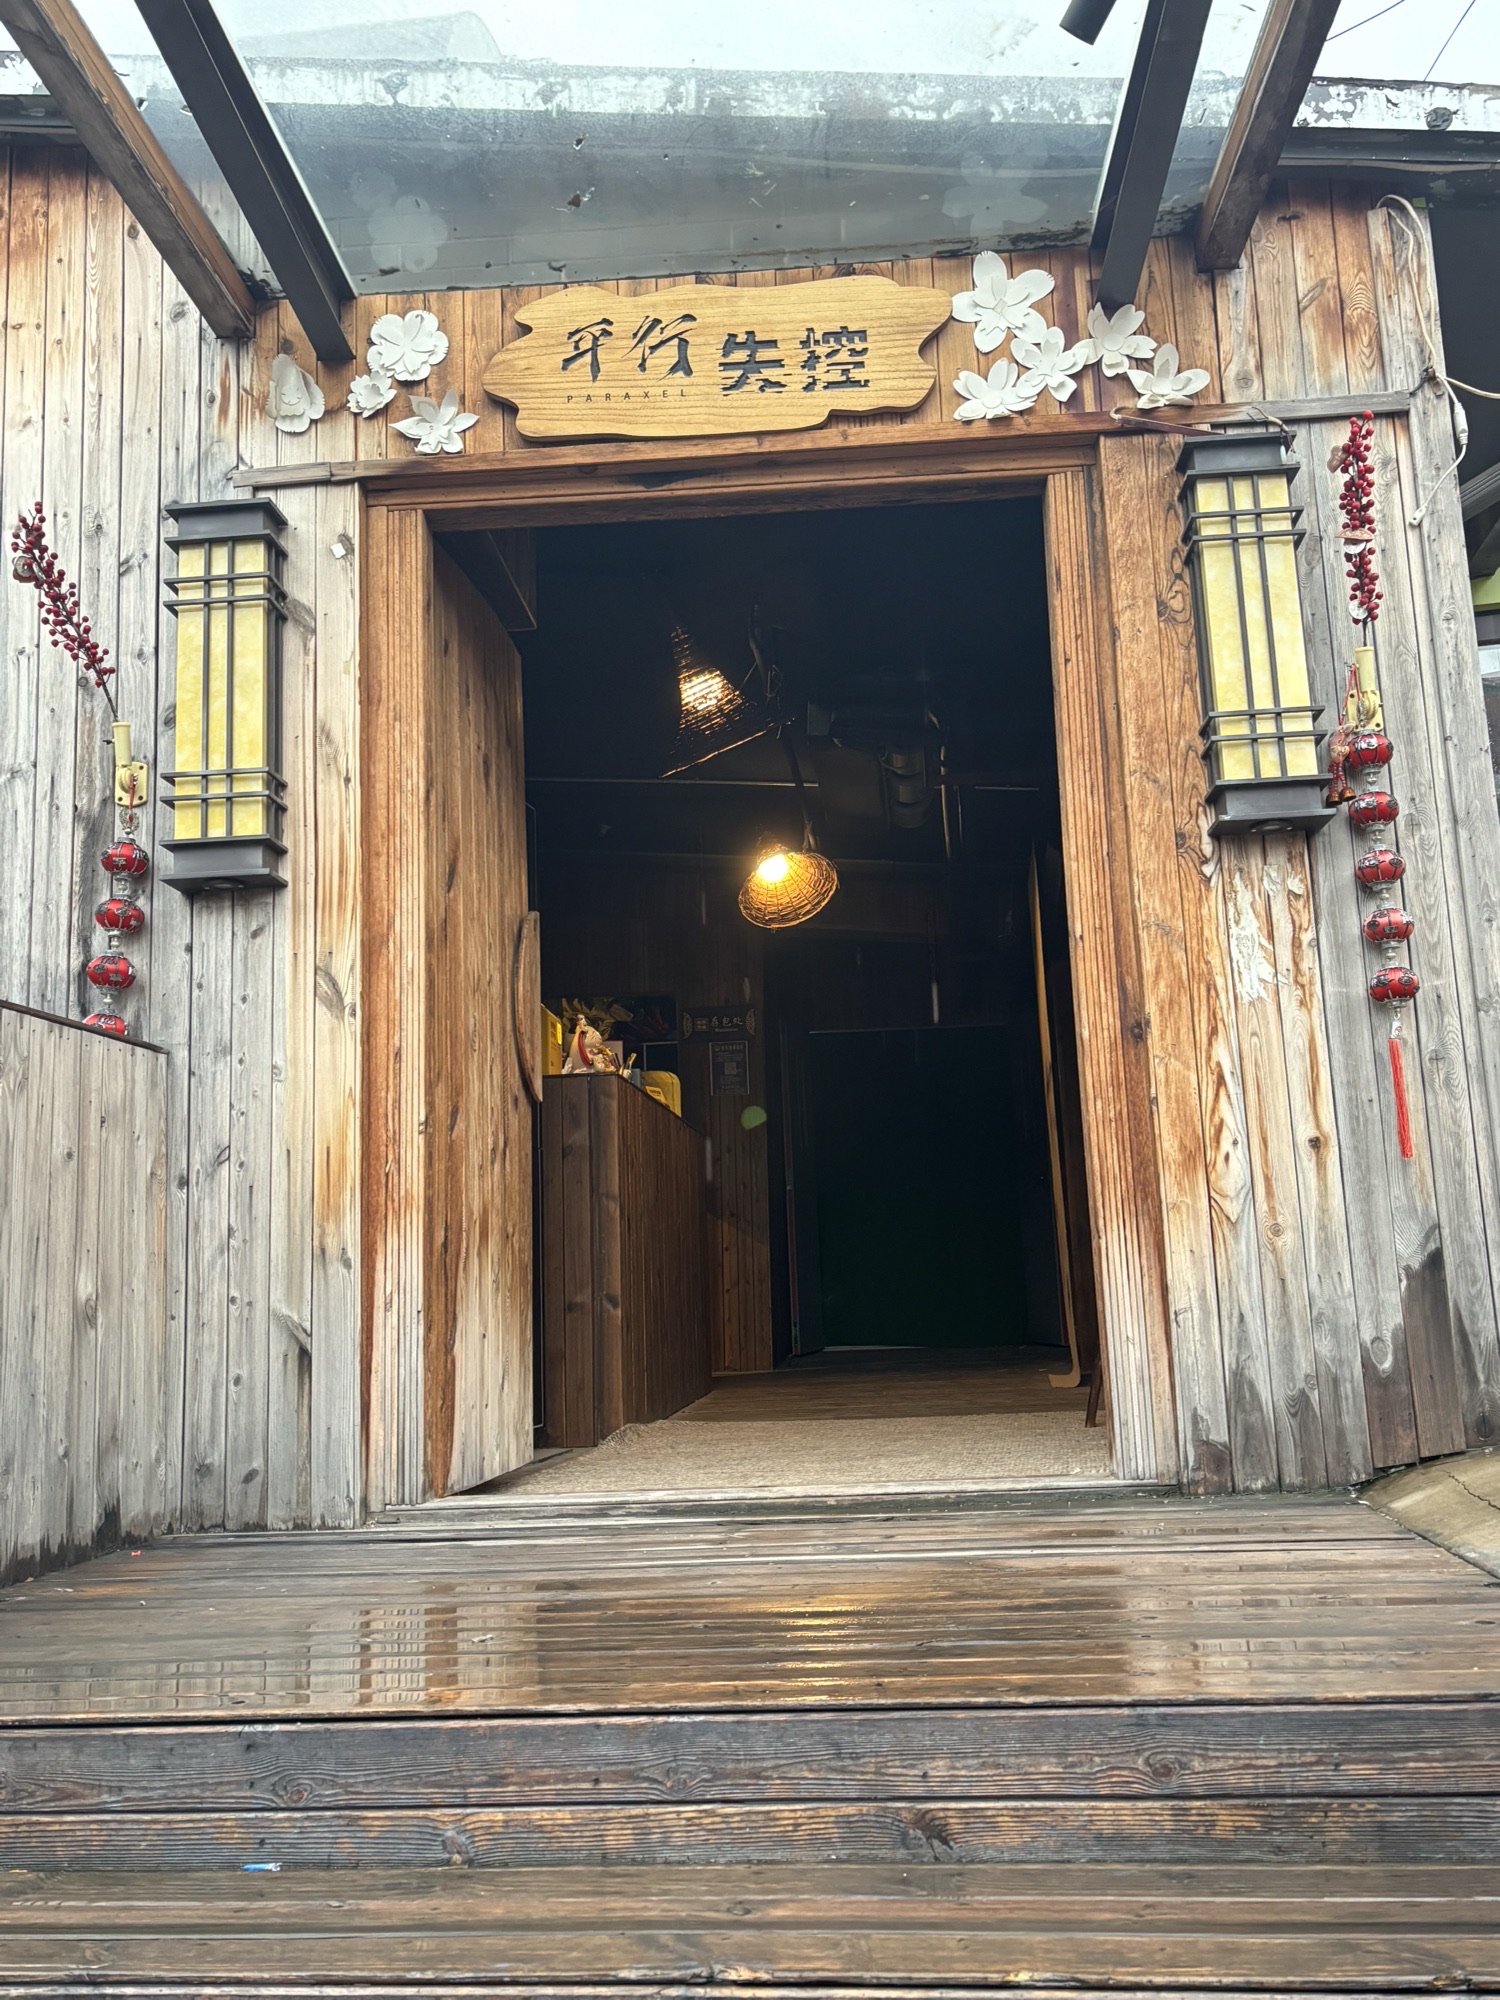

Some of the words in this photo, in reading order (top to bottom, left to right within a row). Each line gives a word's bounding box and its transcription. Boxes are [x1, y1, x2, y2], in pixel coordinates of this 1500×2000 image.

[567, 387, 687, 403] PARAXEL
[711, 1016, 744, 1028] 存包处
